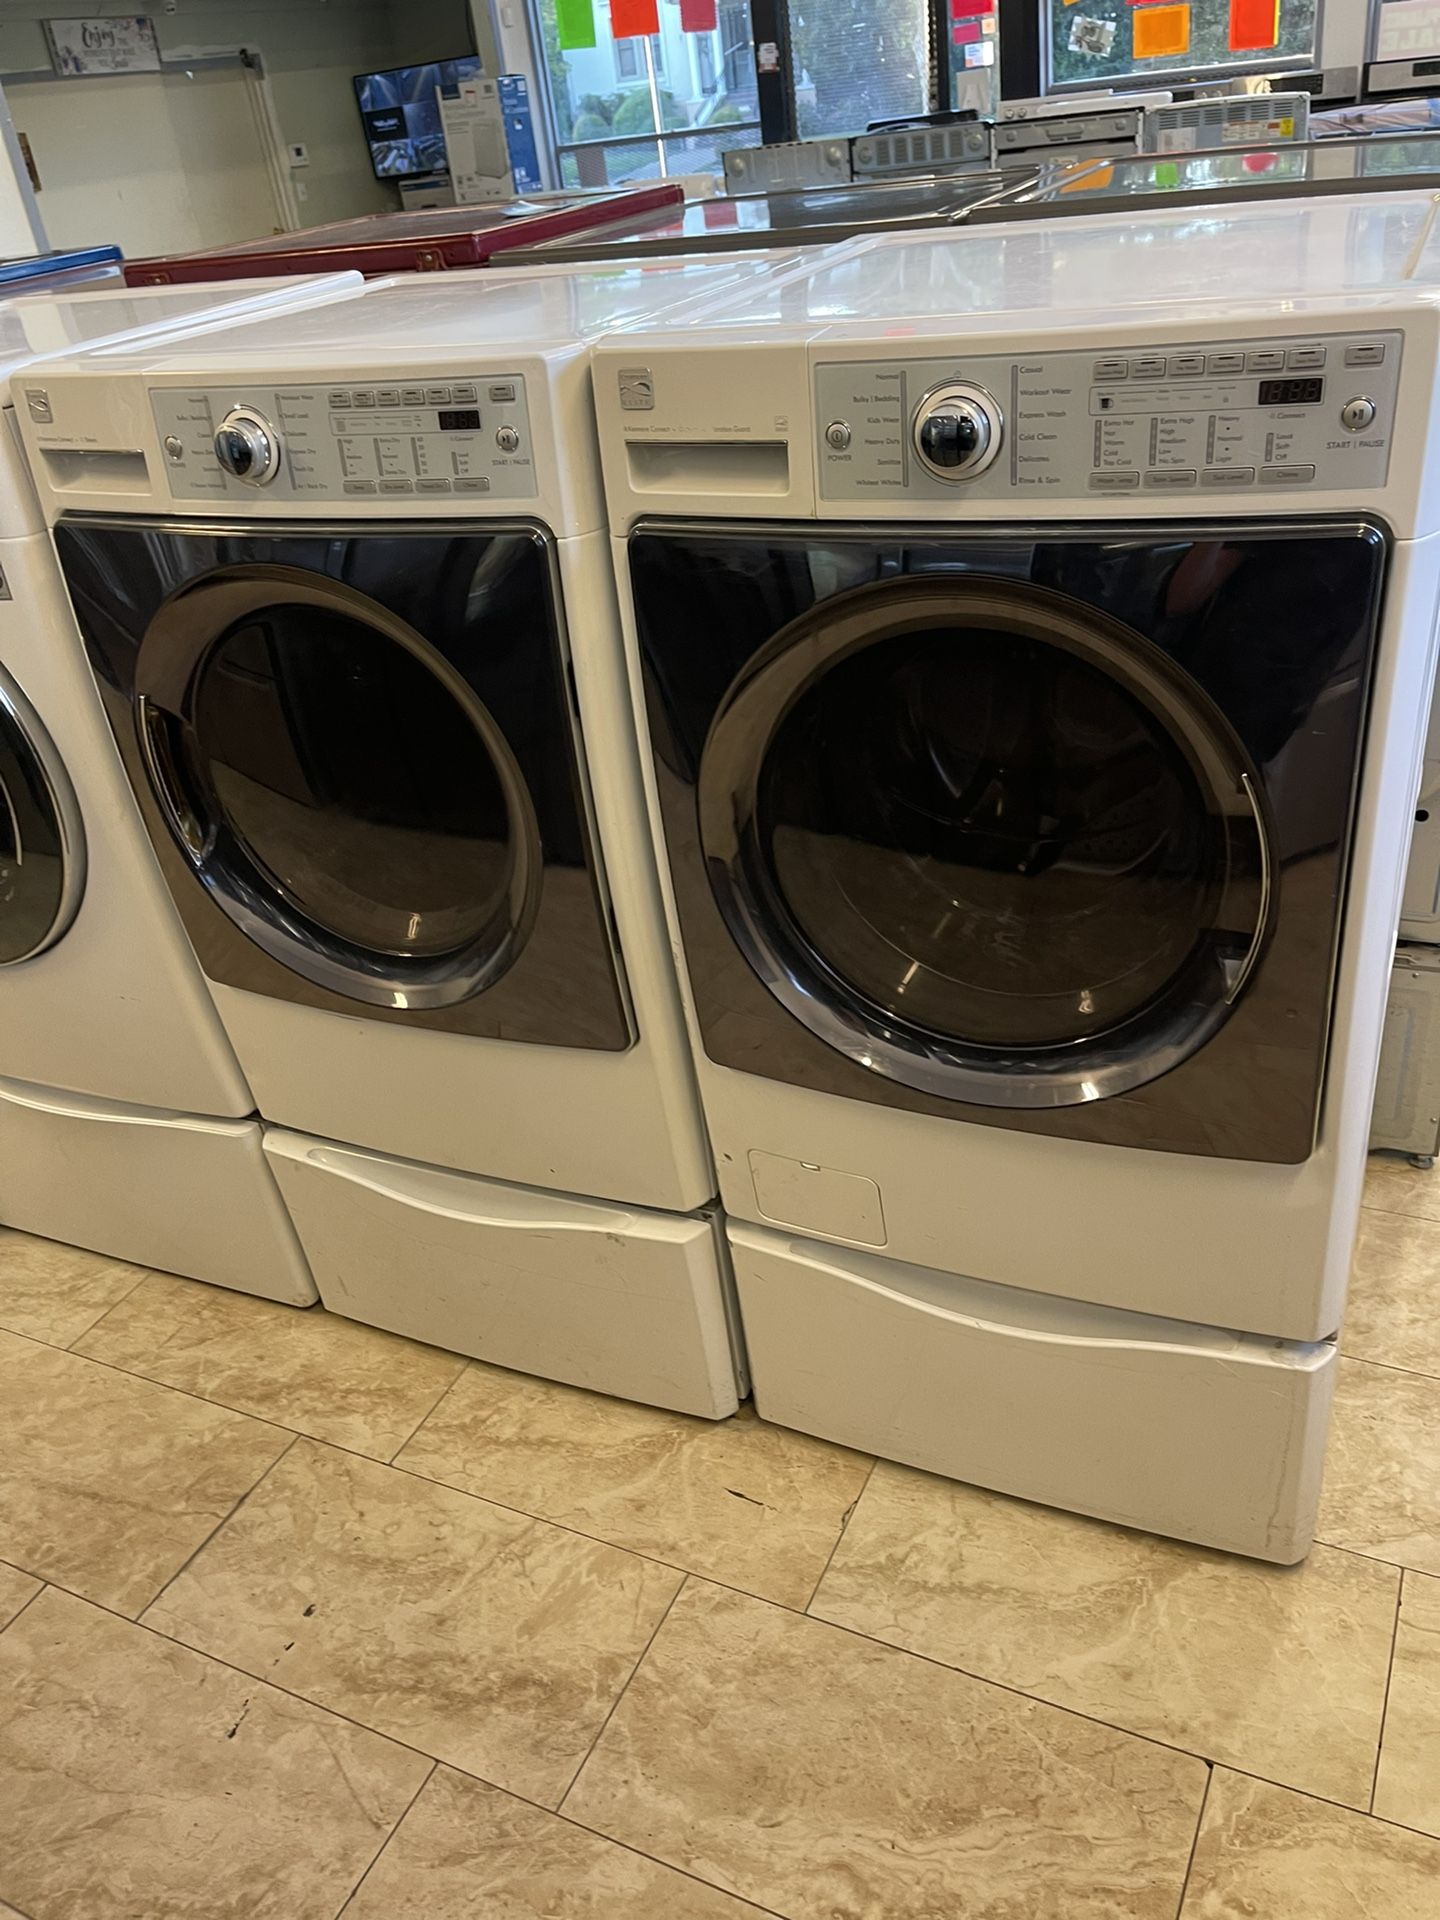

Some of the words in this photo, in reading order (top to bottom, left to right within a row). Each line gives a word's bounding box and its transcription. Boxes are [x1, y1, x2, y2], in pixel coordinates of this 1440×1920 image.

[81, 22, 116, 49] Enjoy
[1019, 366, 1043, 374] Casual
[874, 395, 900, 403] Bedding
[1019, 433, 1035, 441] Cold
[1036, 432, 1058, 440] Clean
[1326, 441, 1351, 450] START
[1358, 439, 1385, 448] PAUSE
